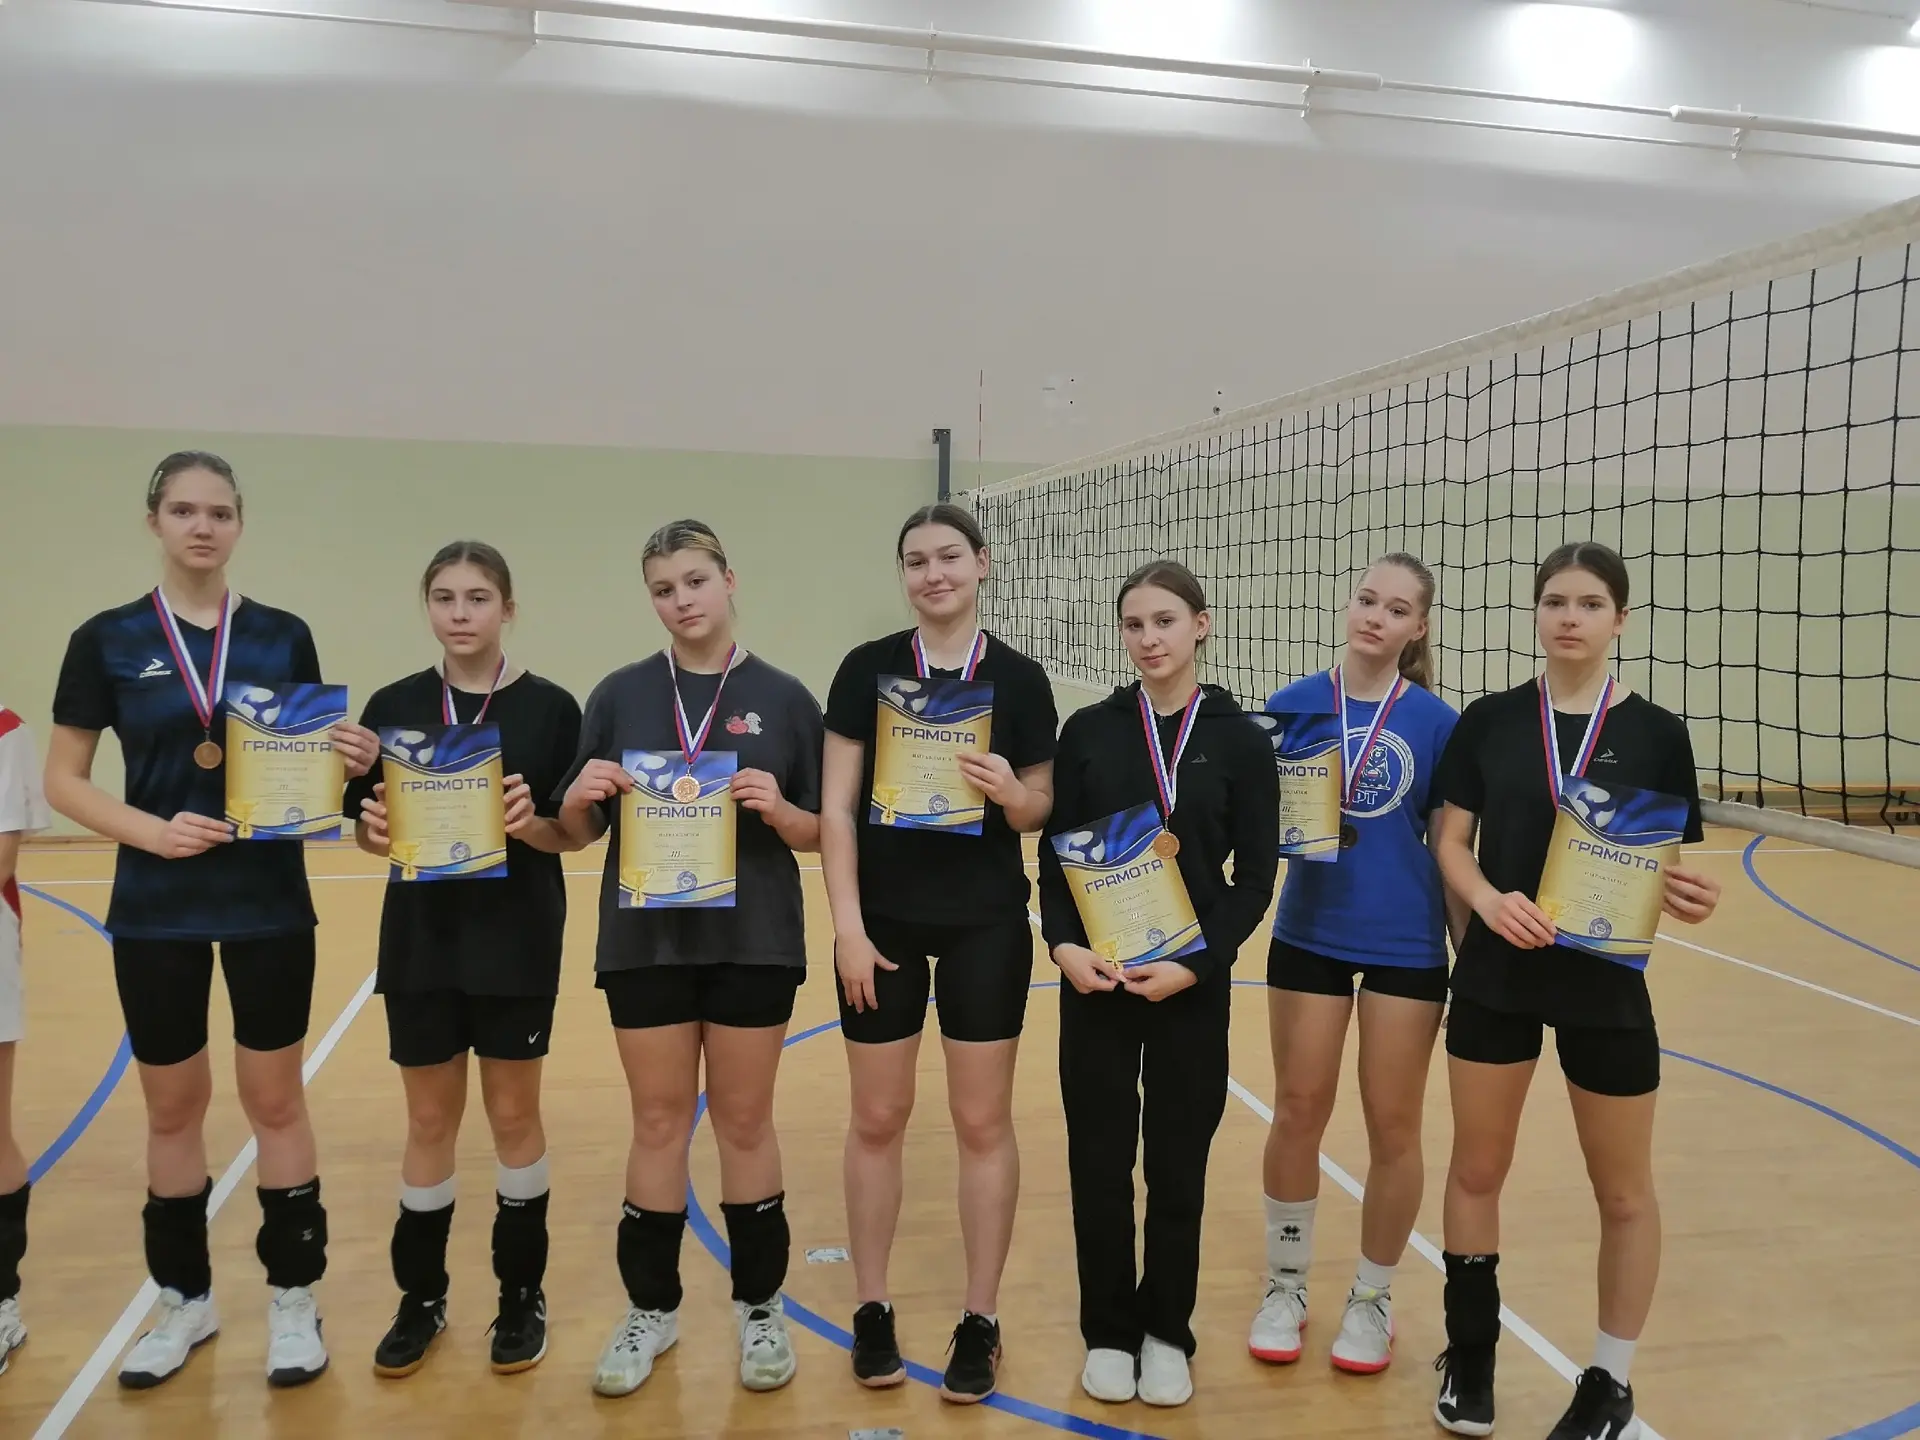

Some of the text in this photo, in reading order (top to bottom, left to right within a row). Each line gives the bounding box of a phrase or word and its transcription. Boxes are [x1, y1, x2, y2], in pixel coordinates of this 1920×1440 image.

[892, 725, 976, 745] ГРАМОТА
[243, 740, 333, 753] ГРАМОТА
[1276, 765, 1329, 778] АМОТА
[401, 777, 489, 793] ГРАМОТА
[636, 805, 722, 818] ГРАМОТА
[1567, 838, 1659, 873] ГРАМОТА
[1084, 858, 1164, 894] ГРАМОТА
